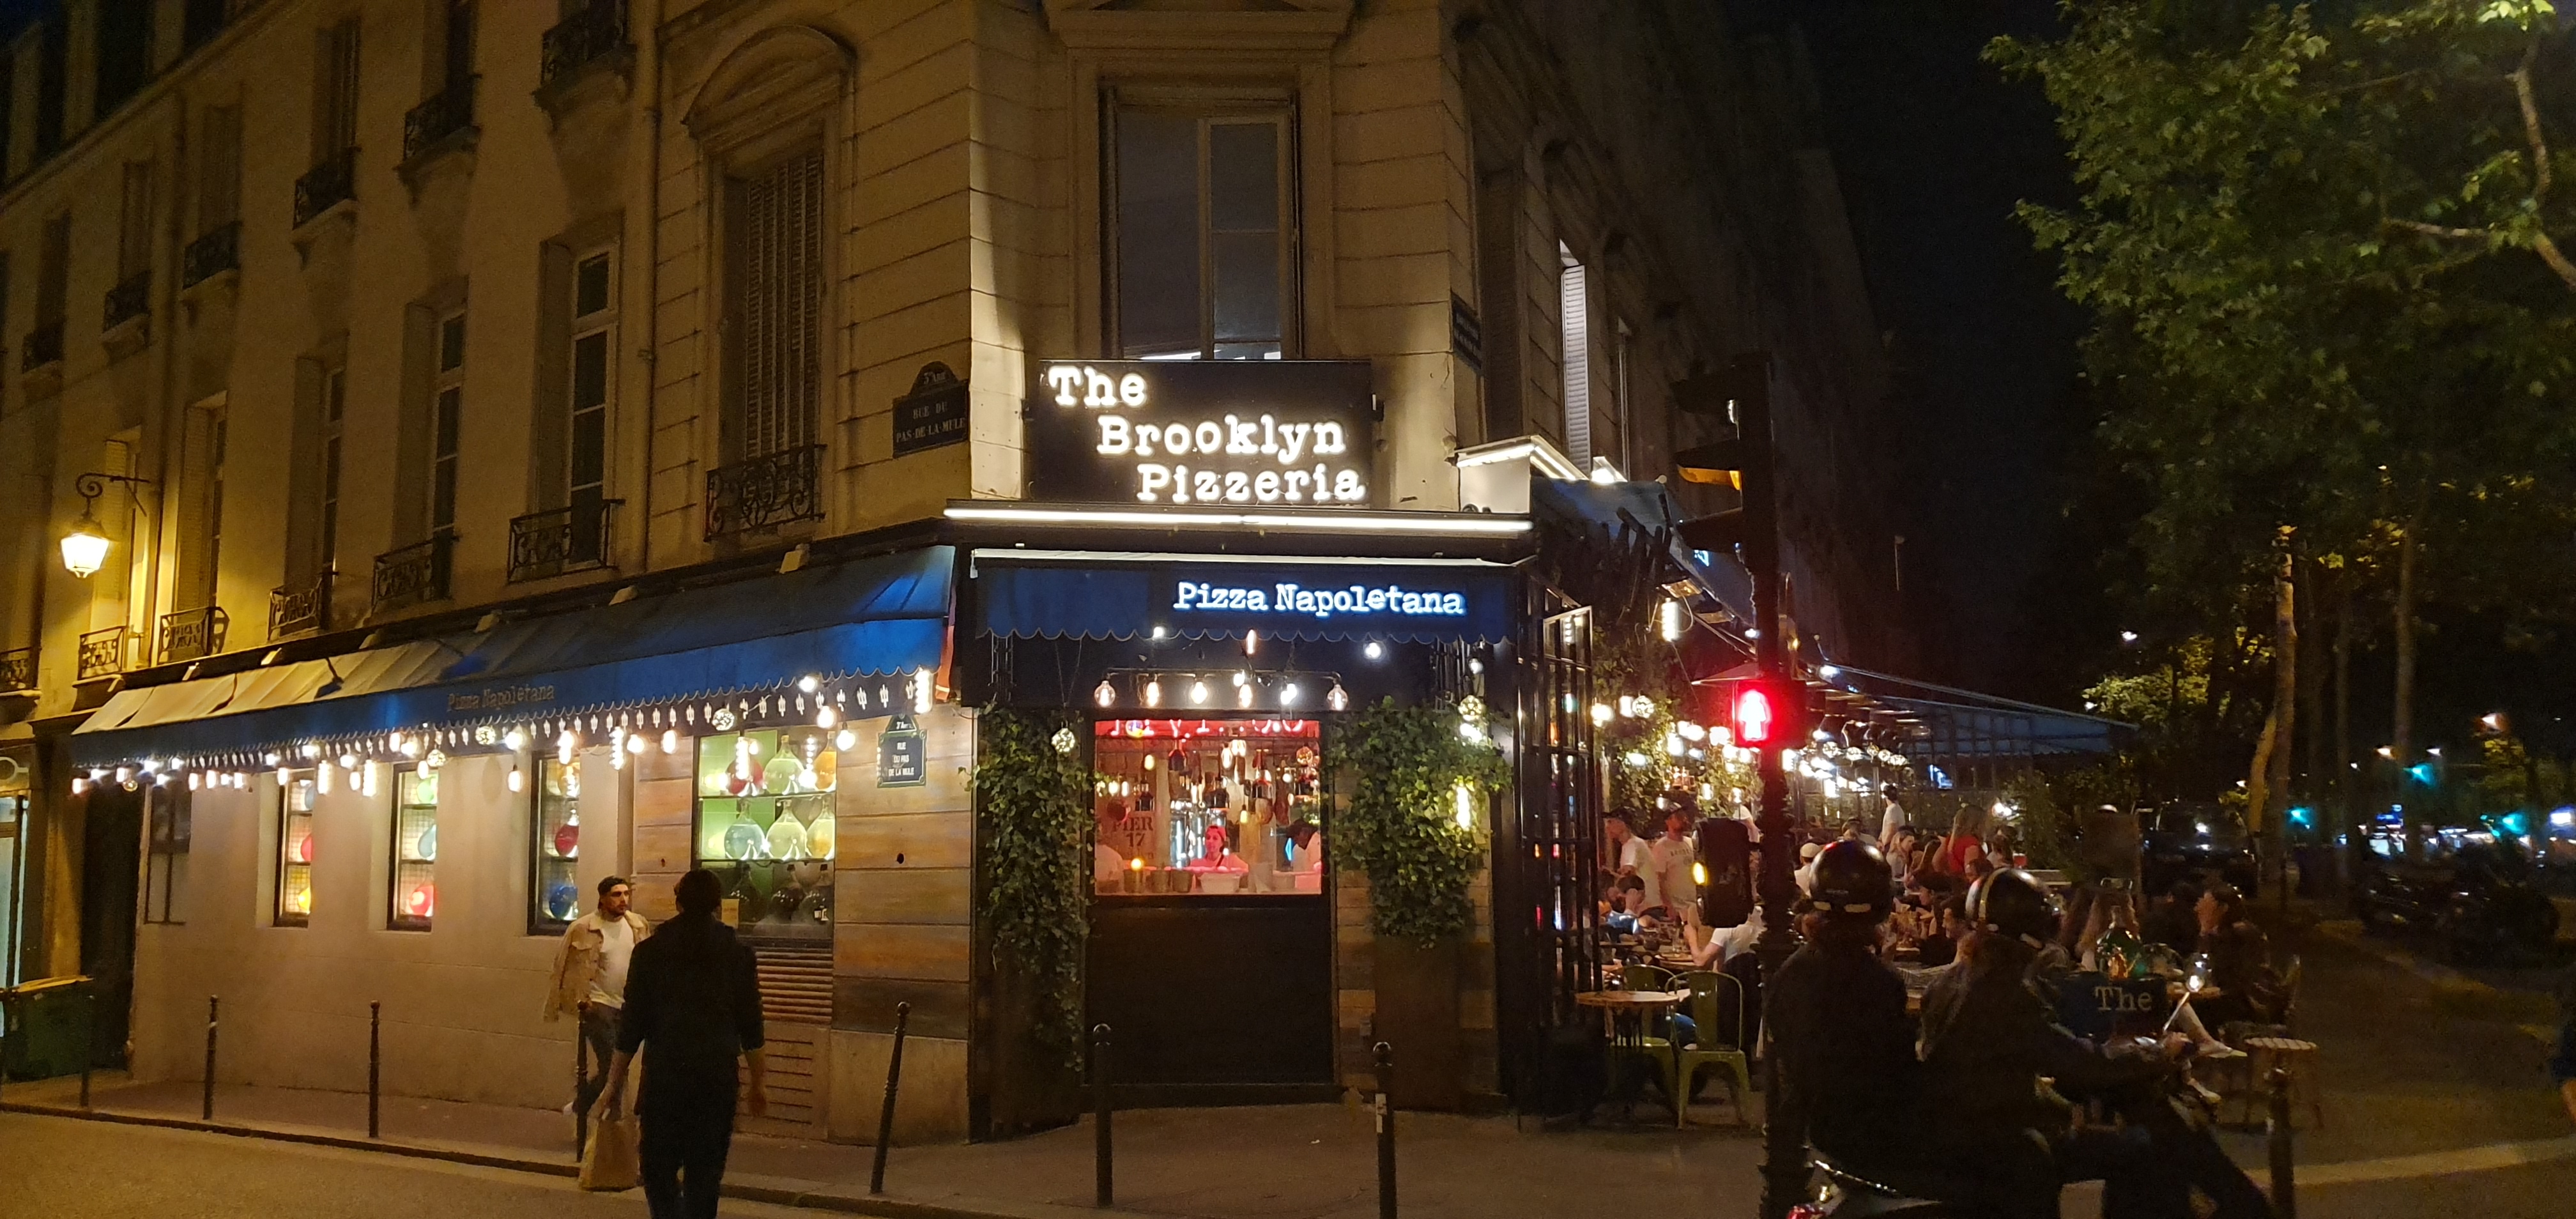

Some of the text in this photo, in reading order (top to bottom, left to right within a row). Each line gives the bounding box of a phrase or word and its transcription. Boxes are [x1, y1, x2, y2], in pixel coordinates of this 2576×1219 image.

[1048, 365, 1147, 407] The
[912, 401, 947, 420] RUE DU
[1096, 413, 1346, 464] Brooklyn
[1137, 462, 1365, 503] Pizzeria
[1173, 581, 1466, 617] Pizza Napoletana
[481, 684, 555, 710] Napoletana
[1126, 832, 1145, 847] 17
[2095, 986, 2153, 1011] The
